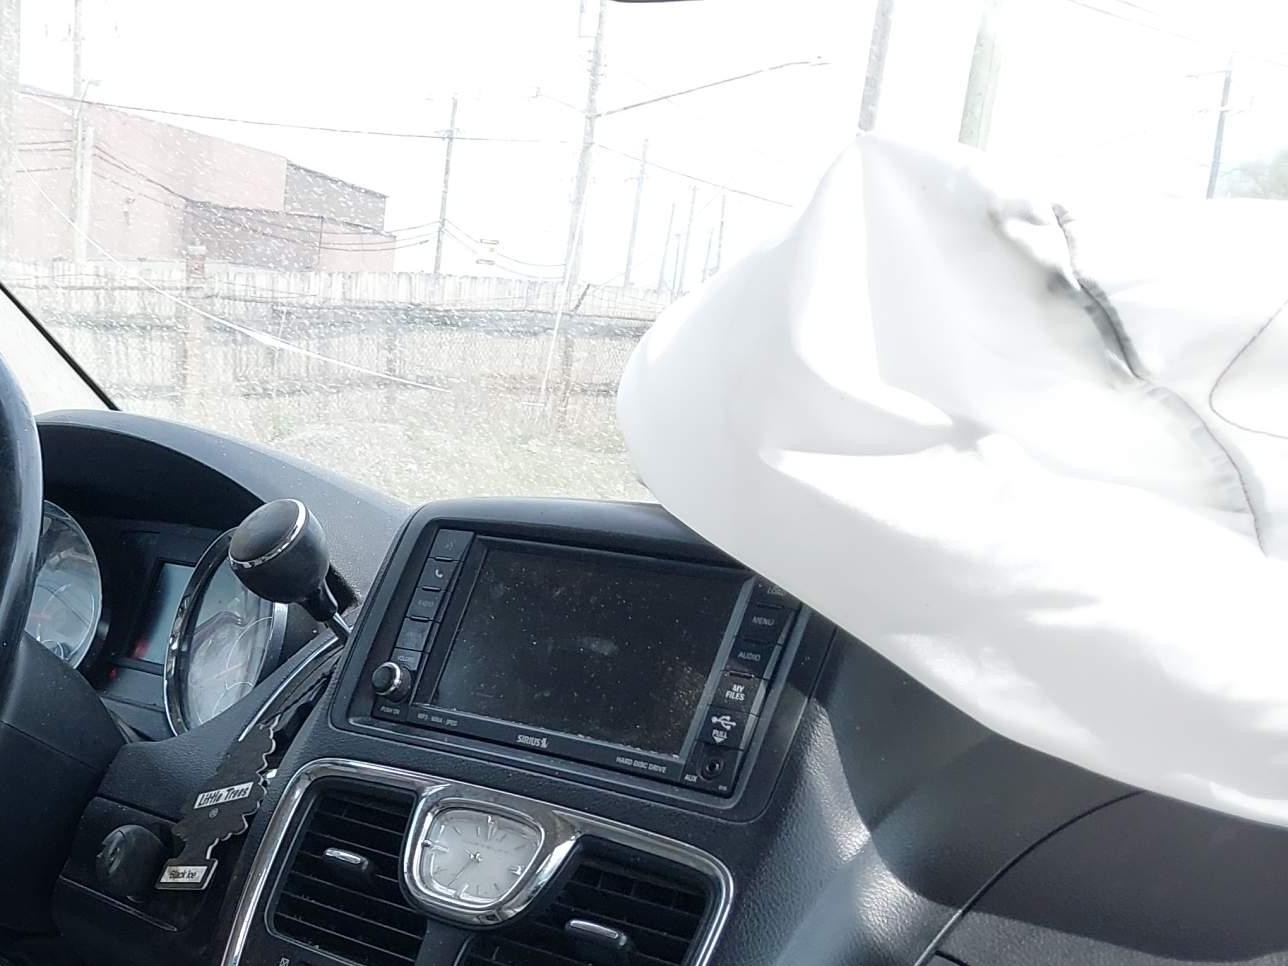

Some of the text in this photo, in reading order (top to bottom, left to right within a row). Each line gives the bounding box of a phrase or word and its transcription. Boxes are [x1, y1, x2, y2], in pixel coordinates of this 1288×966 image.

[752, 616, 775, 626] MENU
[737, 651, 761, 662] AUDIO
[732, 683, 744, 693] MY
[725, 690, 745, 701] FILES
[516, 734, 541, 747] SIRIUS
[648, 764, 667, 774] DRIVE
[684, 774, 697, 783] AUX
[224, 788, 249, 801] Trees
